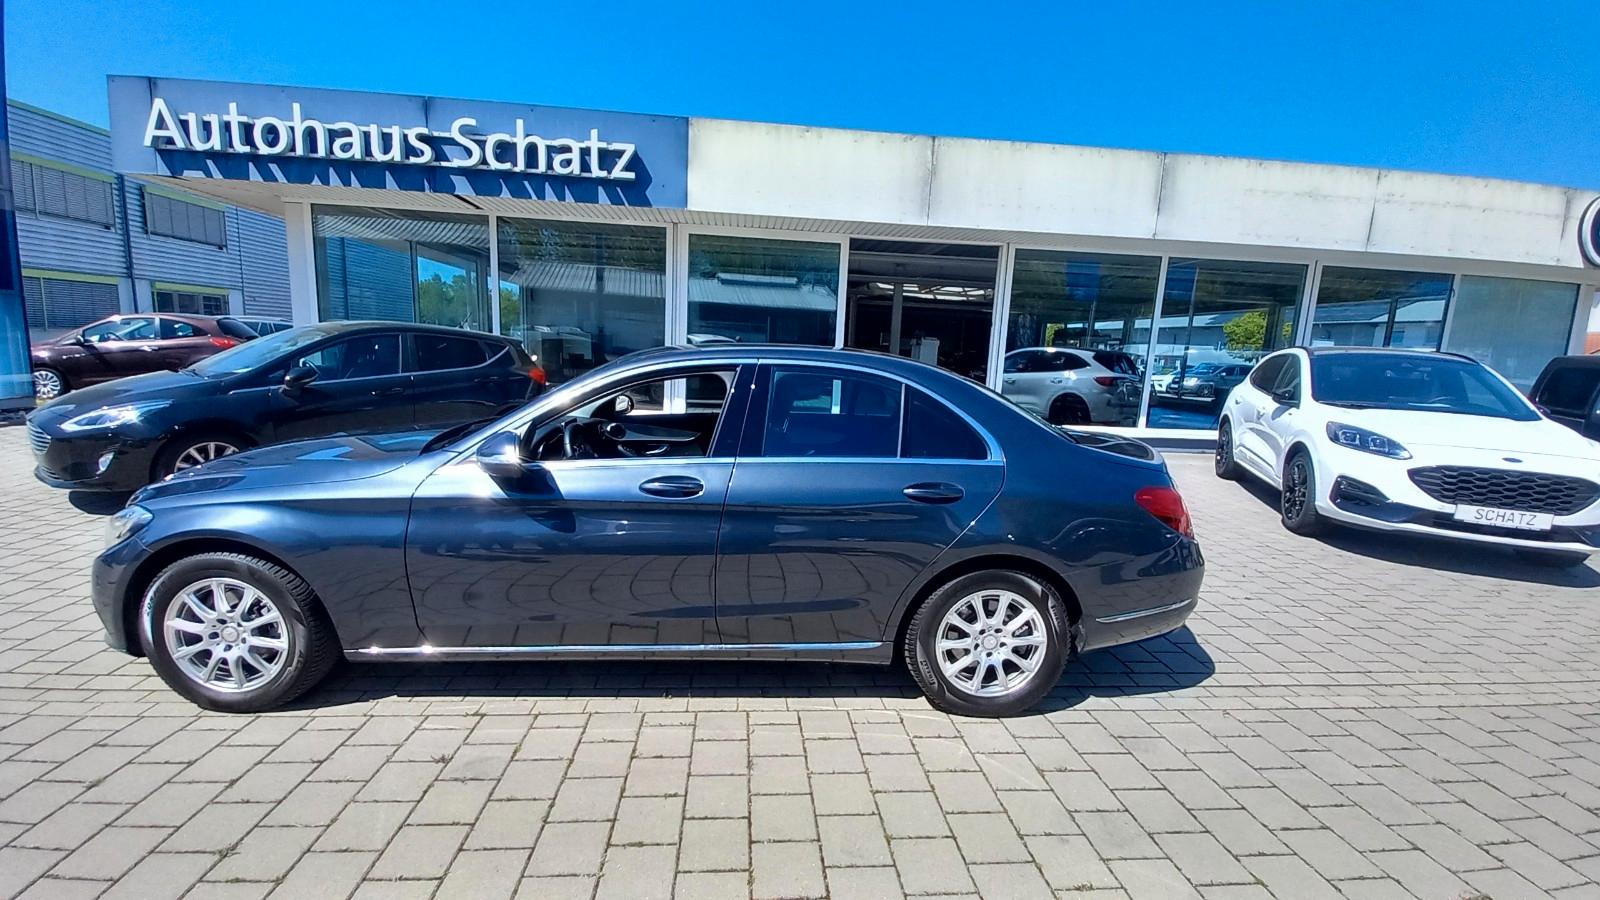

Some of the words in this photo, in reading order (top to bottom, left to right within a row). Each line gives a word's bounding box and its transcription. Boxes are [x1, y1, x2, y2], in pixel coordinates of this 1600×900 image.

[143, 97, 434, 165] Autohaus
[450, 117, 637, 180] Schatz
[1474, 508, 1537, 526] SCHATZ
